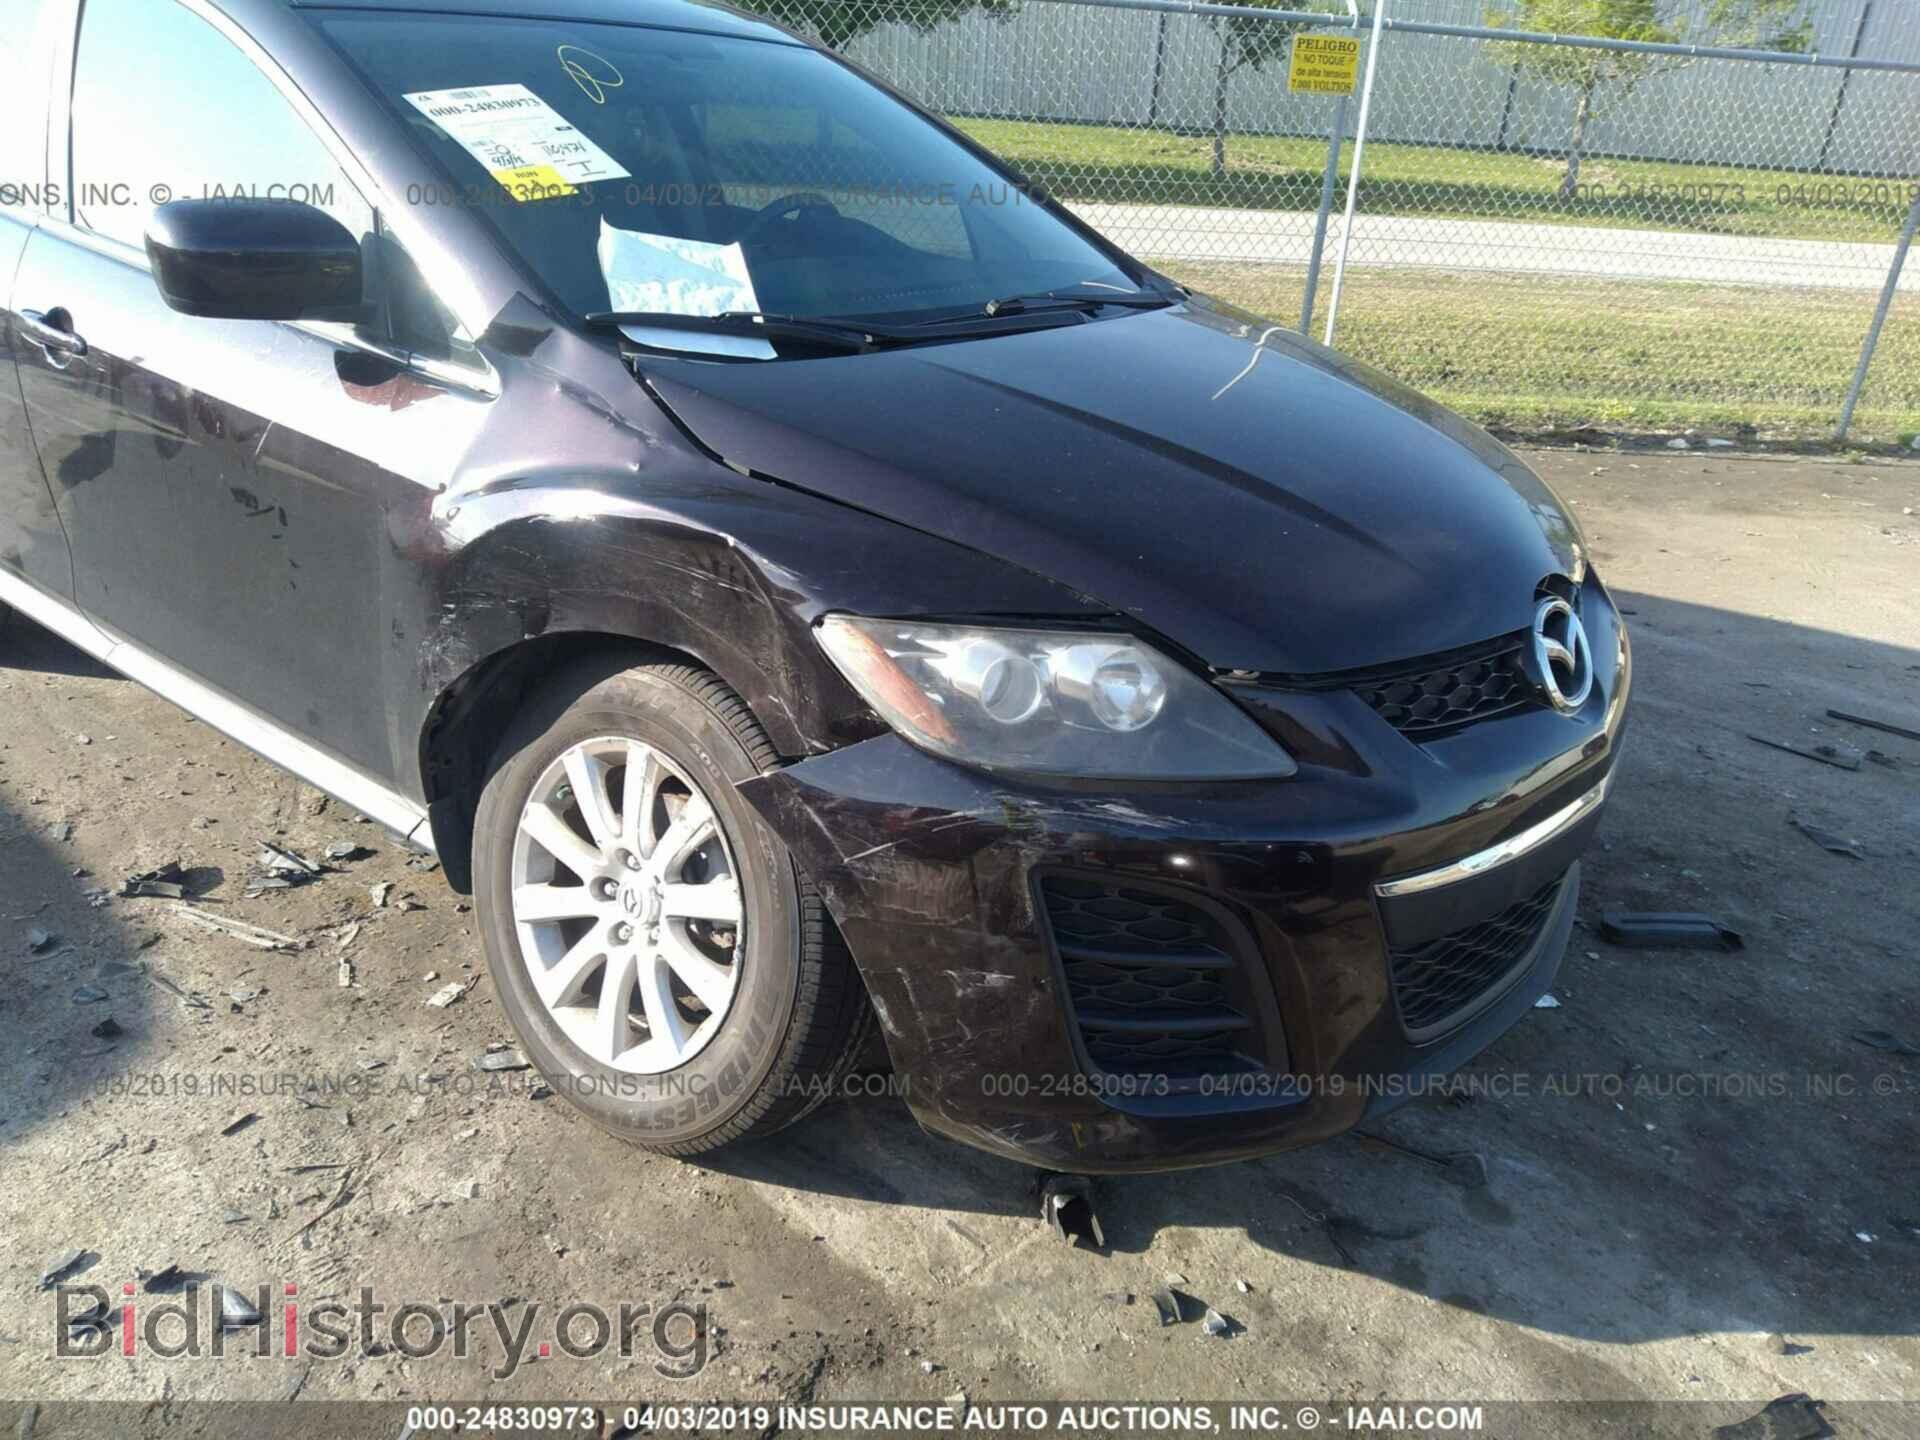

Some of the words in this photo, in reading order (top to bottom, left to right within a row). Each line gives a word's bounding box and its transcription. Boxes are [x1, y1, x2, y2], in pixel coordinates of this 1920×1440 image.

[1297, 38, 1357, 53] PELIGRO
[1304, 53, 1315, 64] NO
[1317, 54, 1345, 66] TOQUE
